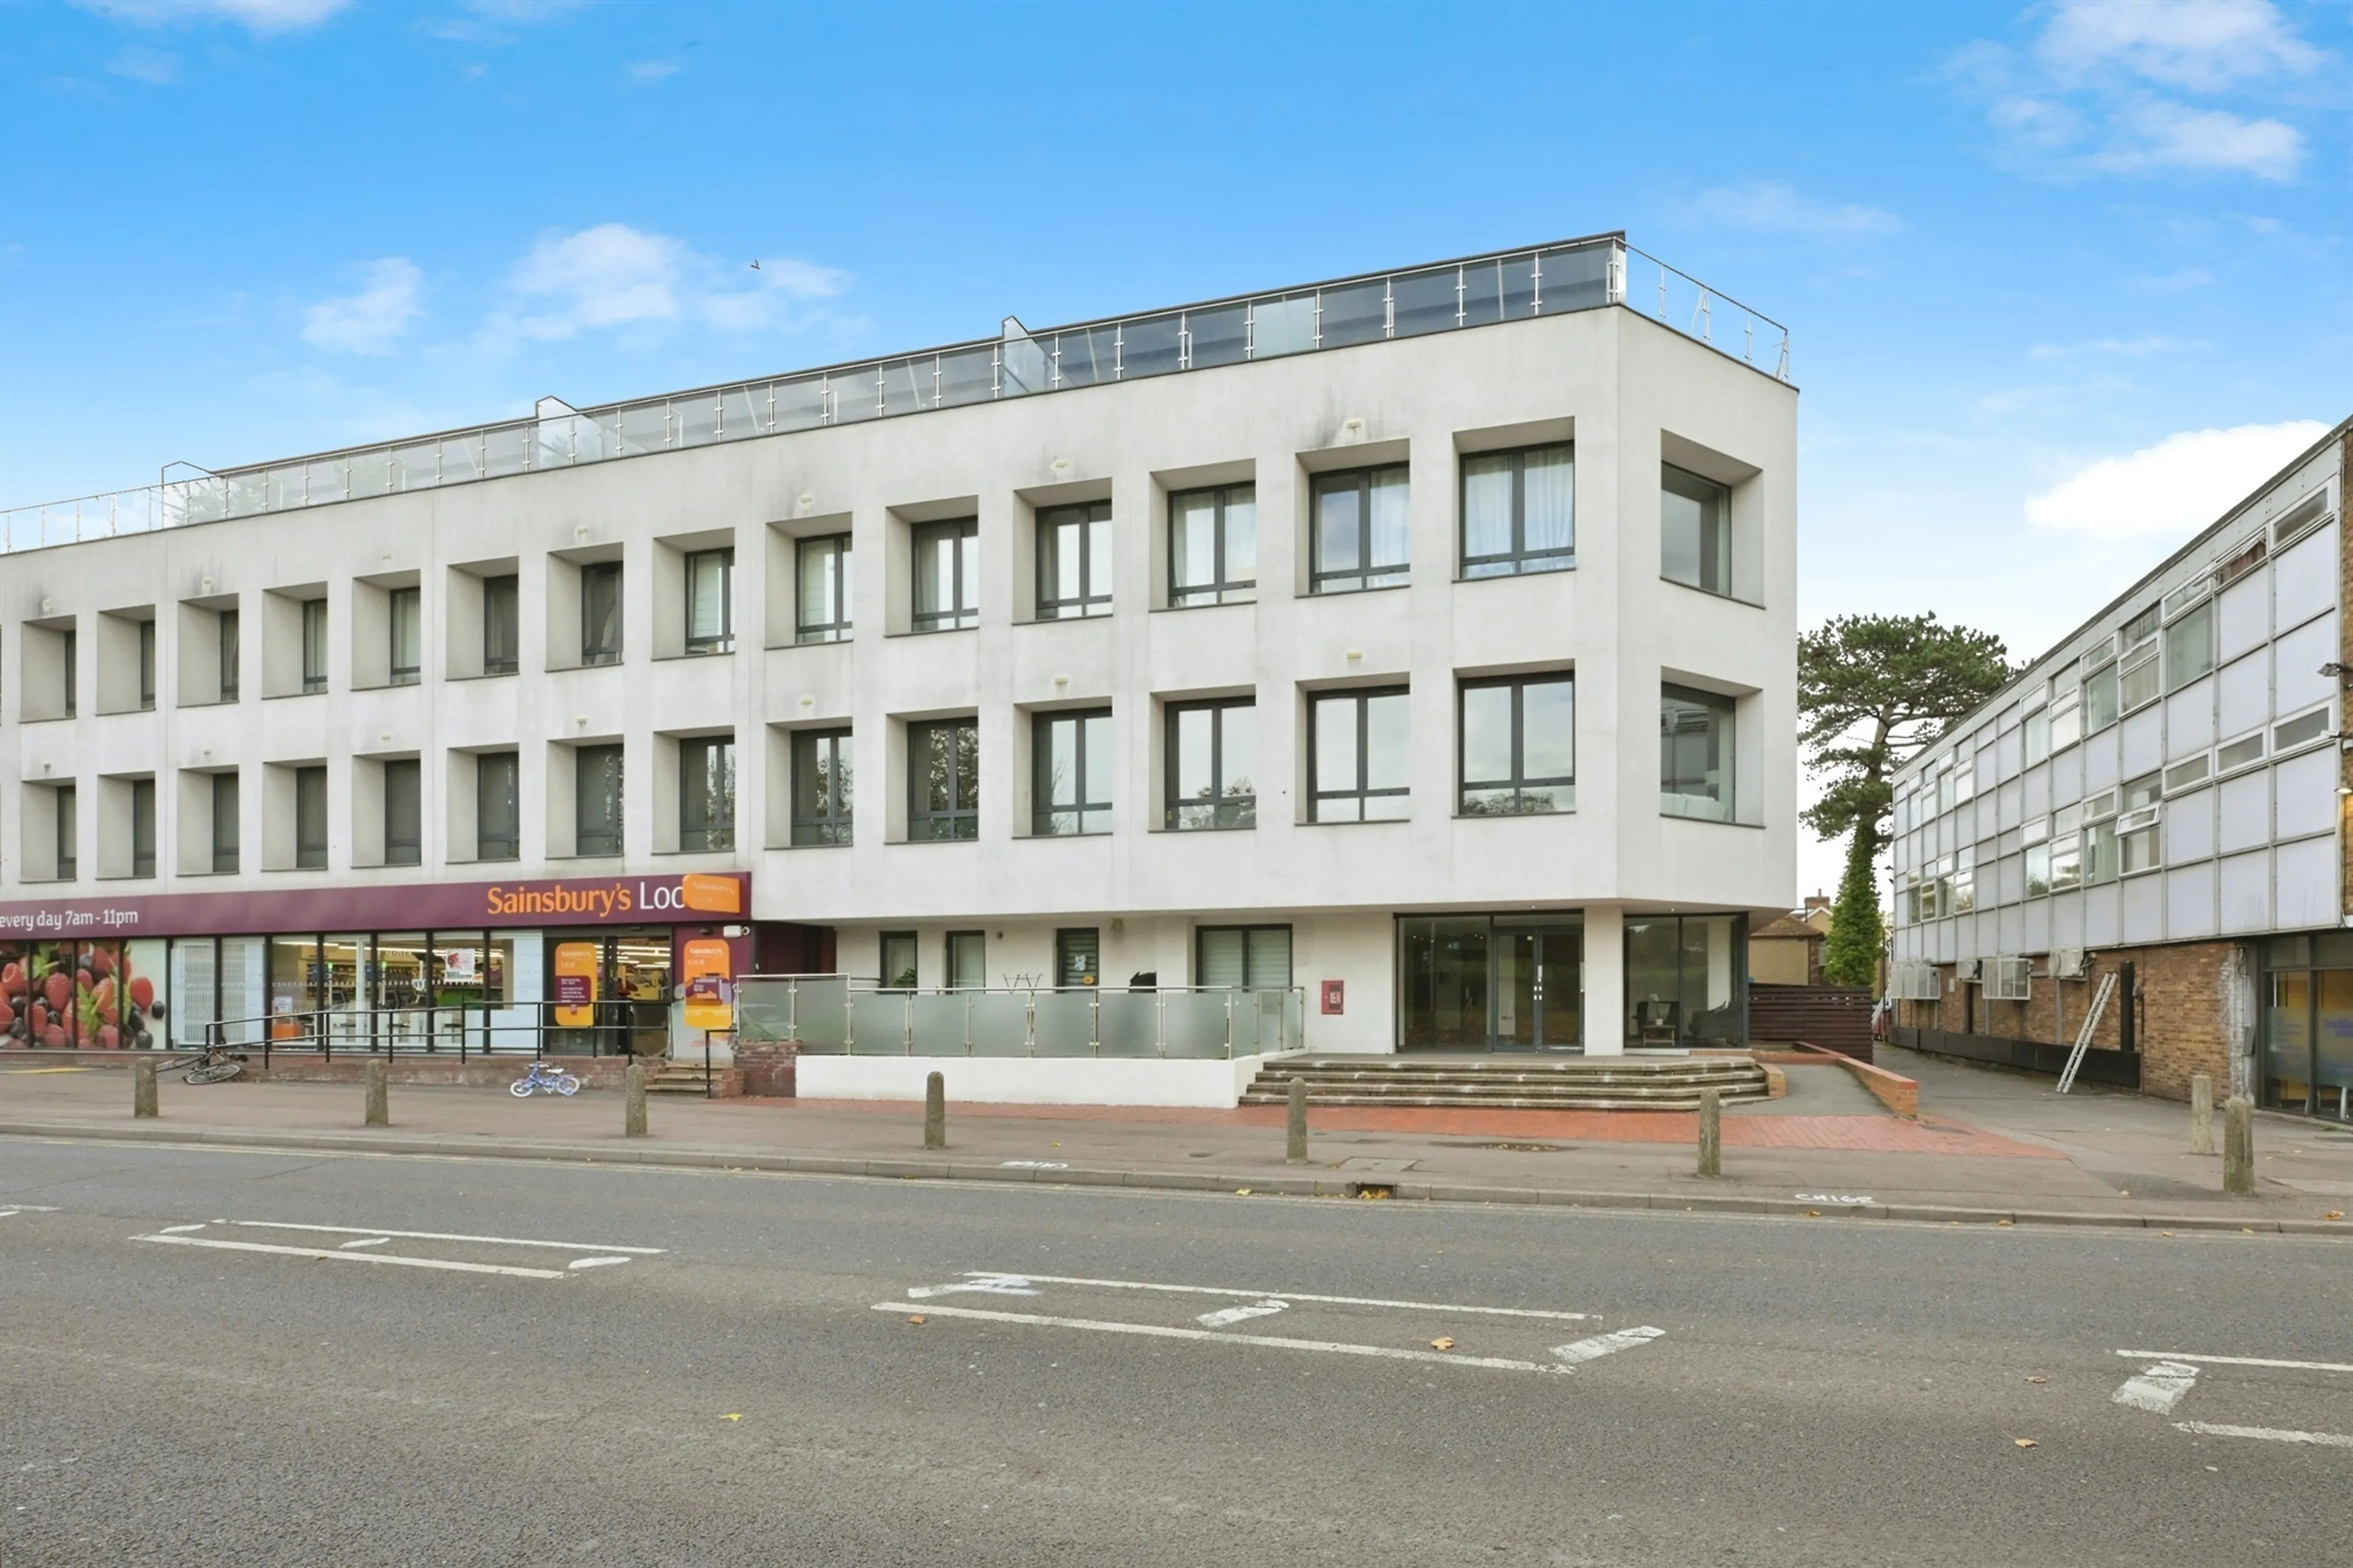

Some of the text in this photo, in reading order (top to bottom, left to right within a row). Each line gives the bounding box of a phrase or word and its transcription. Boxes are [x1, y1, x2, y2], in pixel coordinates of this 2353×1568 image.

[487, 882, 684, 917] Sainsbury's Loc
[0, 915, 33, 931] every
[37, 911, 62, 930] day
[66, 911, 93, 926] 7am
[103, 909, 138, 928] 11pm
